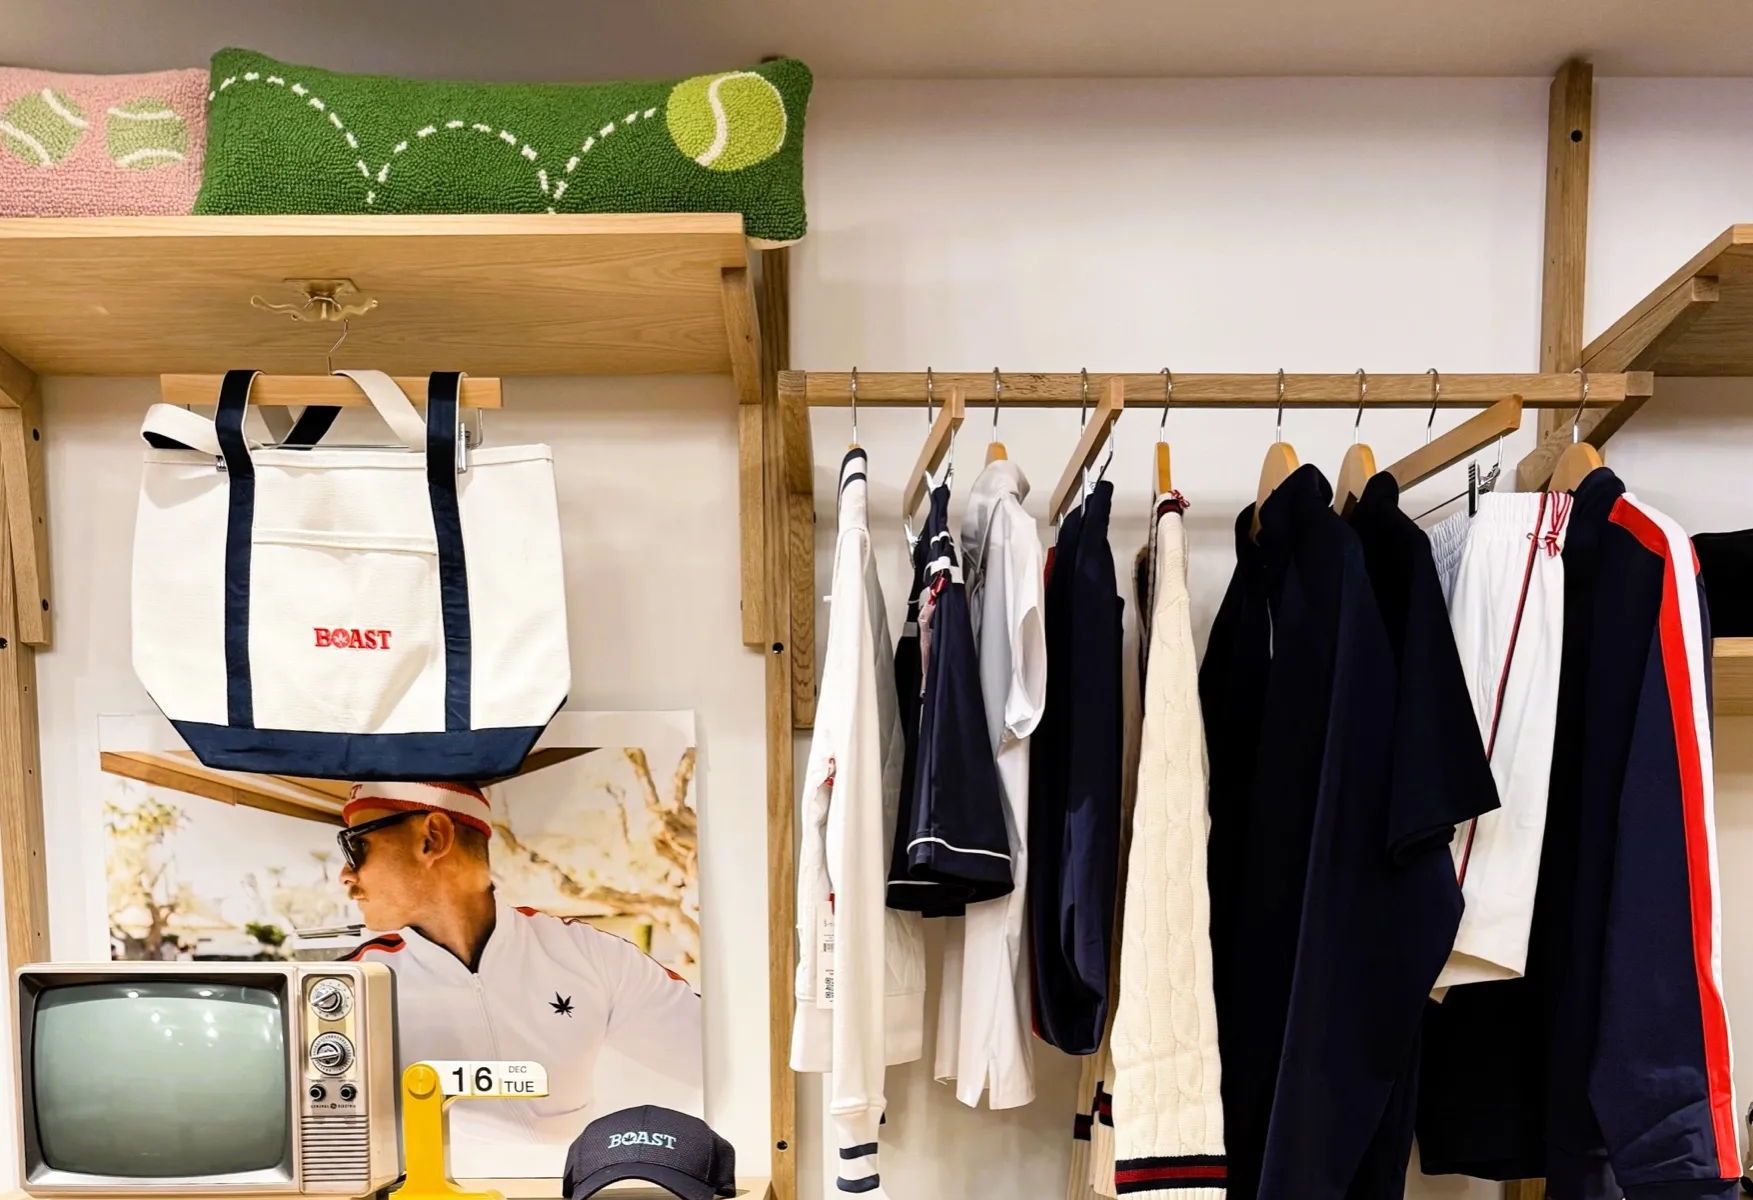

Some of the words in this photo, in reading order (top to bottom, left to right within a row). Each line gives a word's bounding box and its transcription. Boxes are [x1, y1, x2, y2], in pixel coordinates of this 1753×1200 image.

[313, 627, 392, 649] BOAST
[508, 1065, 527, 1073] DEC
[452, 1066, 493, 1092] 16
[504, 1081, 535, 1092] TUE
[607, 1131, 677, 1150] BOAST
